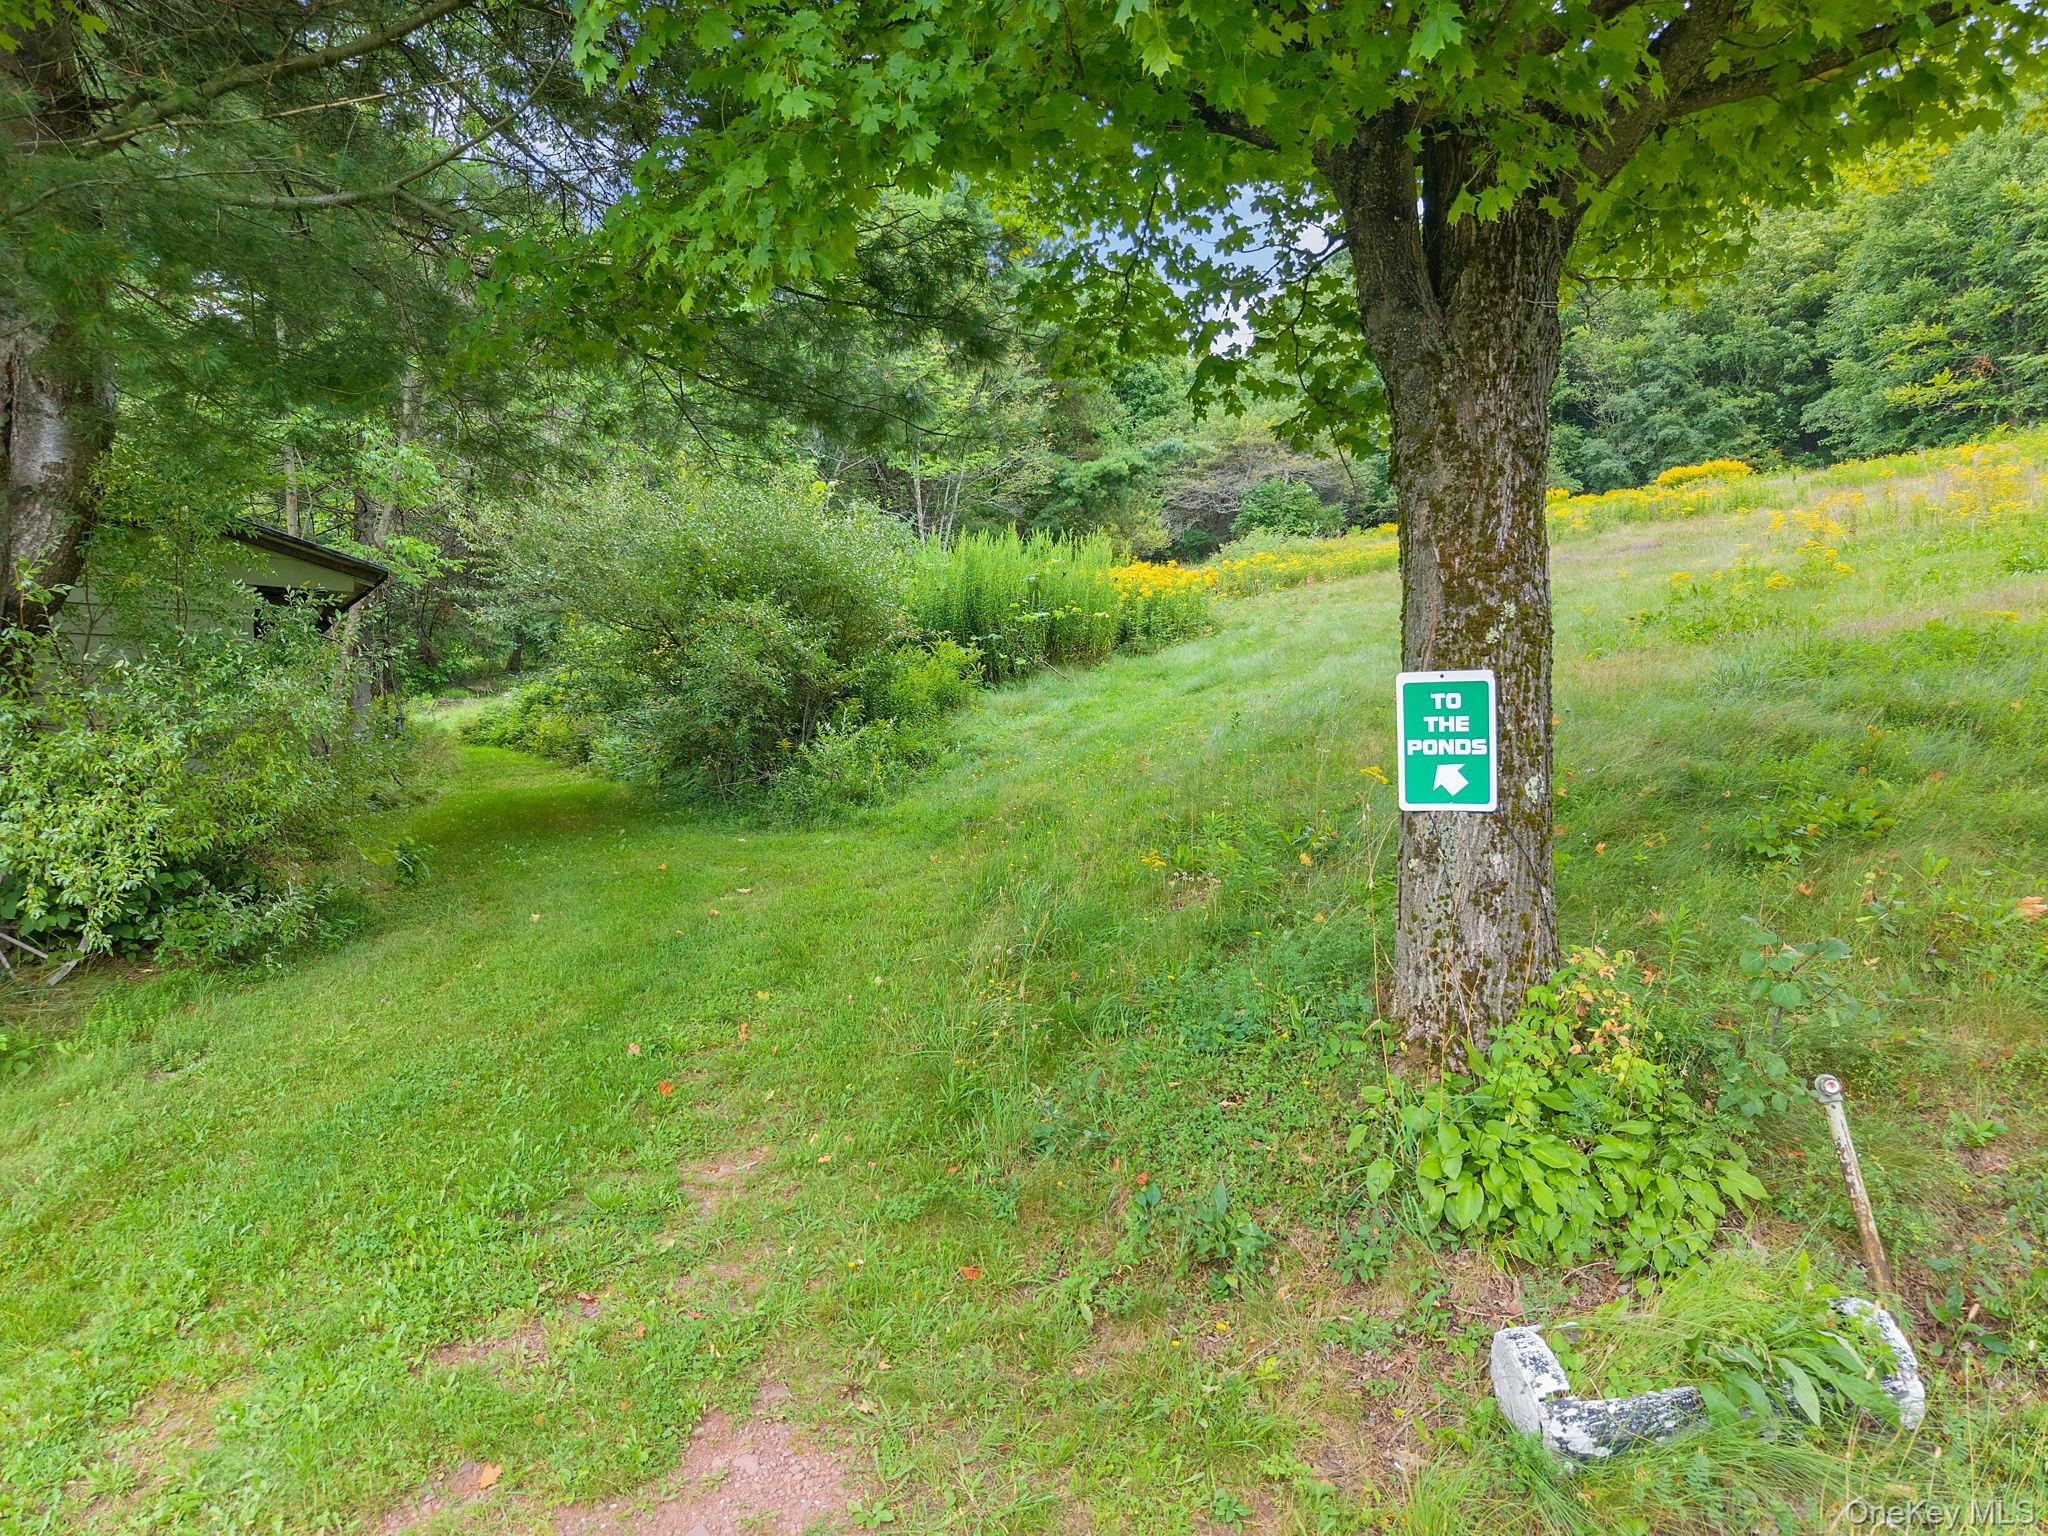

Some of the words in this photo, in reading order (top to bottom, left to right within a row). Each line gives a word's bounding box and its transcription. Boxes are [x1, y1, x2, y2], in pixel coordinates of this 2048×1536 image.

[1431, 693, 1461, 709] TO
[1424, 716, 1469, 732] THE
[1407, 739, 1488, 755] PONDS
